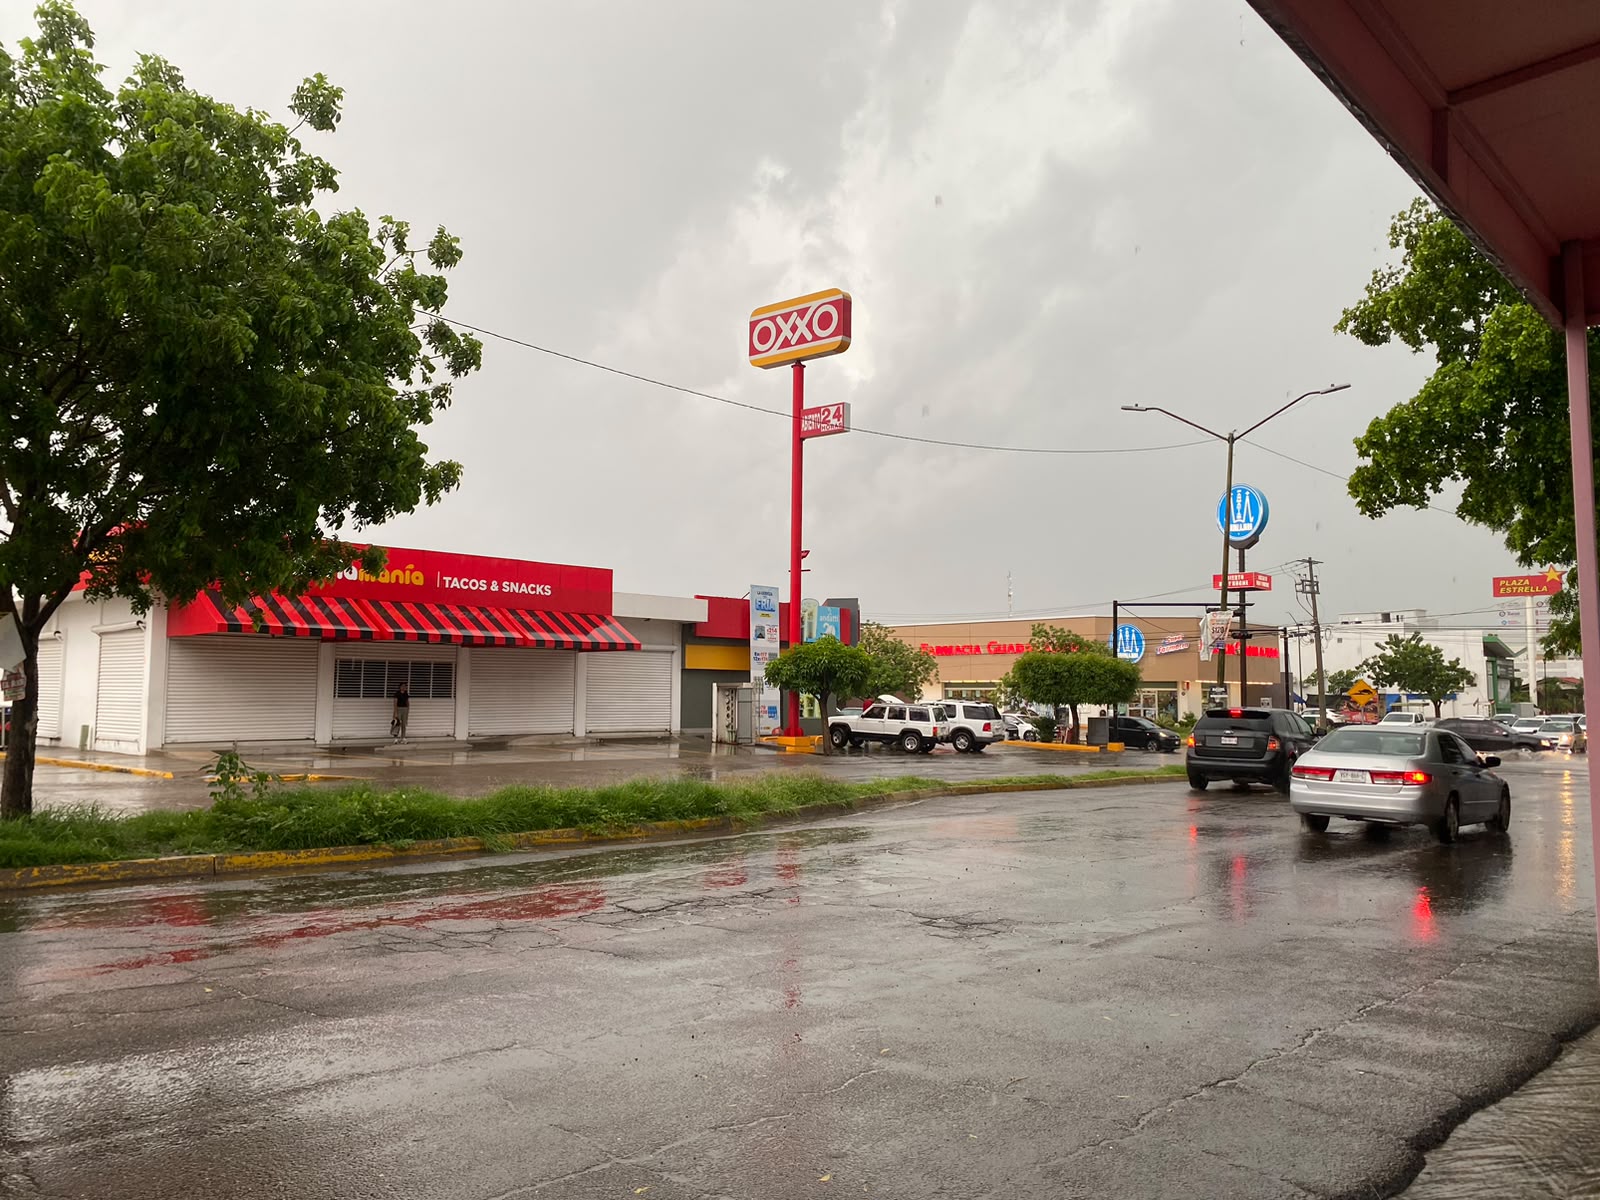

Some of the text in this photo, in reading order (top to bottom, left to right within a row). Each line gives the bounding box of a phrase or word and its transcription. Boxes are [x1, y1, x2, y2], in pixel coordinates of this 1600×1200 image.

[752, 304, 839, 351] OXXO
[822, 406, 842, 423] 24
[443, 576, 552, 596] TACOS & SNACKS
